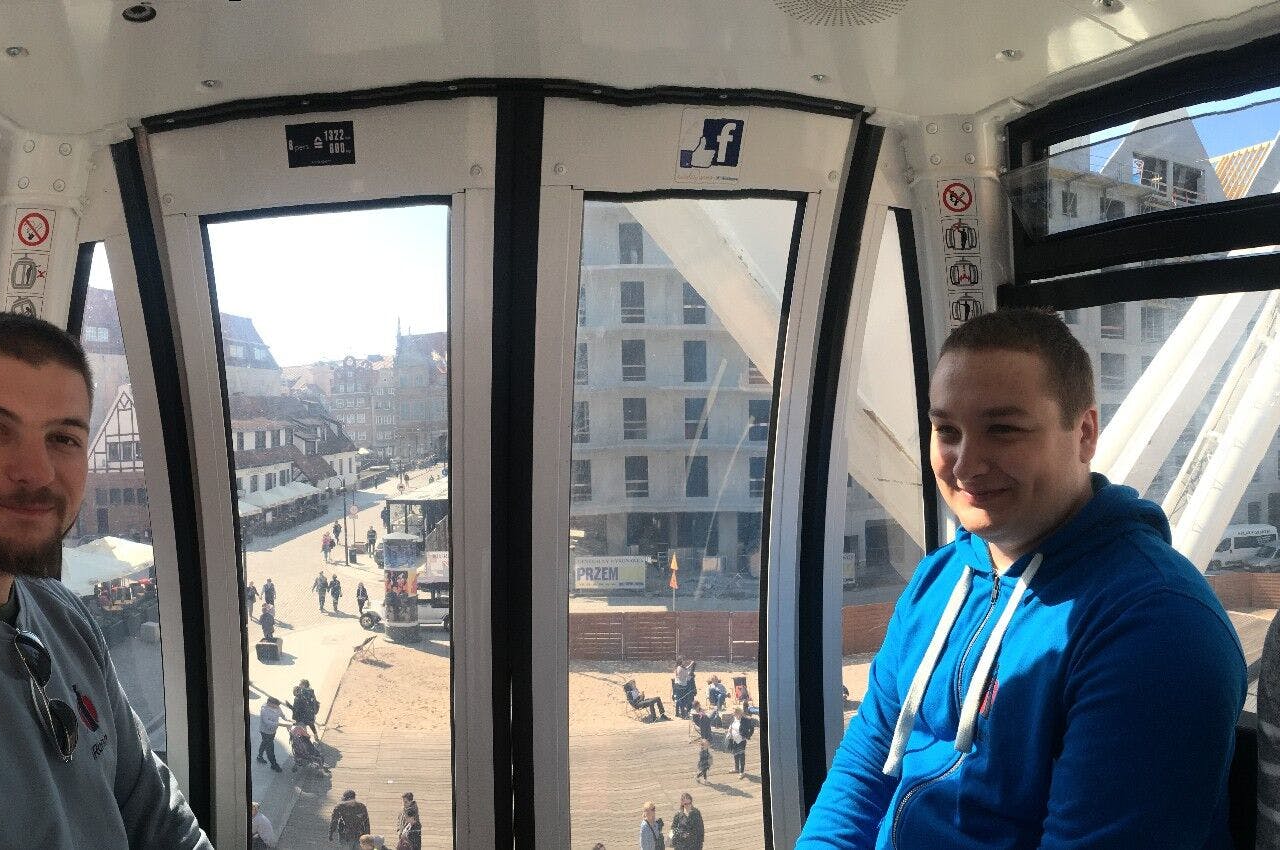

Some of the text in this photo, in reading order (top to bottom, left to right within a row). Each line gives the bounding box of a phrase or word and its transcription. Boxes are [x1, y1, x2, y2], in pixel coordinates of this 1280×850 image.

[324, 129, 344, 141] 1322
[288, 139, 294, 151] 8
[329, 142, 345, 154] 800
[576, 566, 619, 581] PRZEM
